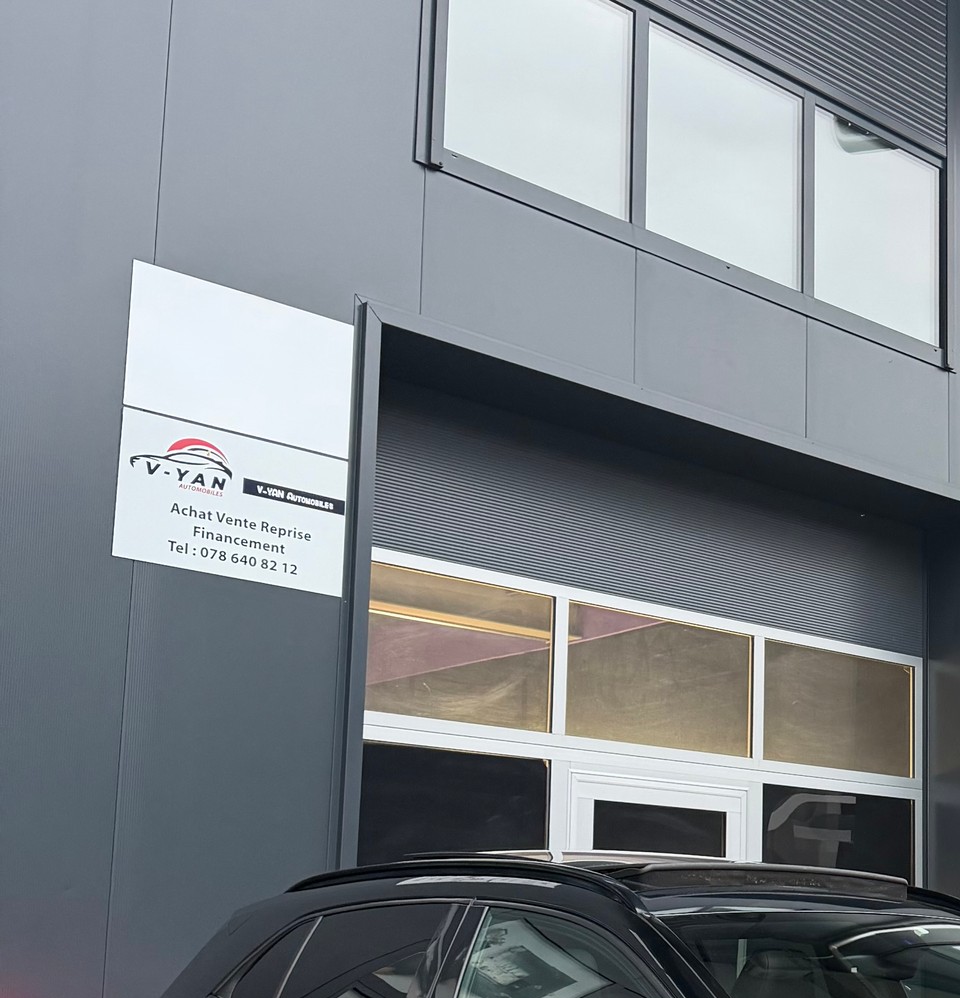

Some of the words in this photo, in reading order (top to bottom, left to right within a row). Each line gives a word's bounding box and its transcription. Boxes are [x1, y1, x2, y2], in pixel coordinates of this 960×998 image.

[146, 461, 226, 490] V-YAN
[179, 483, 223, 497] AUTOMOBILES
[257, 485, 285, 499] V-YAN
[170, 502, 212, 521] Achat
[216, 511, 257, 530] Vente
[261, 521, 312, 541] Reprise
[193, 526, 285, 554] Financement
[168, 540, 188, 554] Tel
[200, 547, 227, 561] 078
[231, 553, 257, 567] 640
[261, 558, 278, 571] 82
[282, 562, 298, 575] 12
